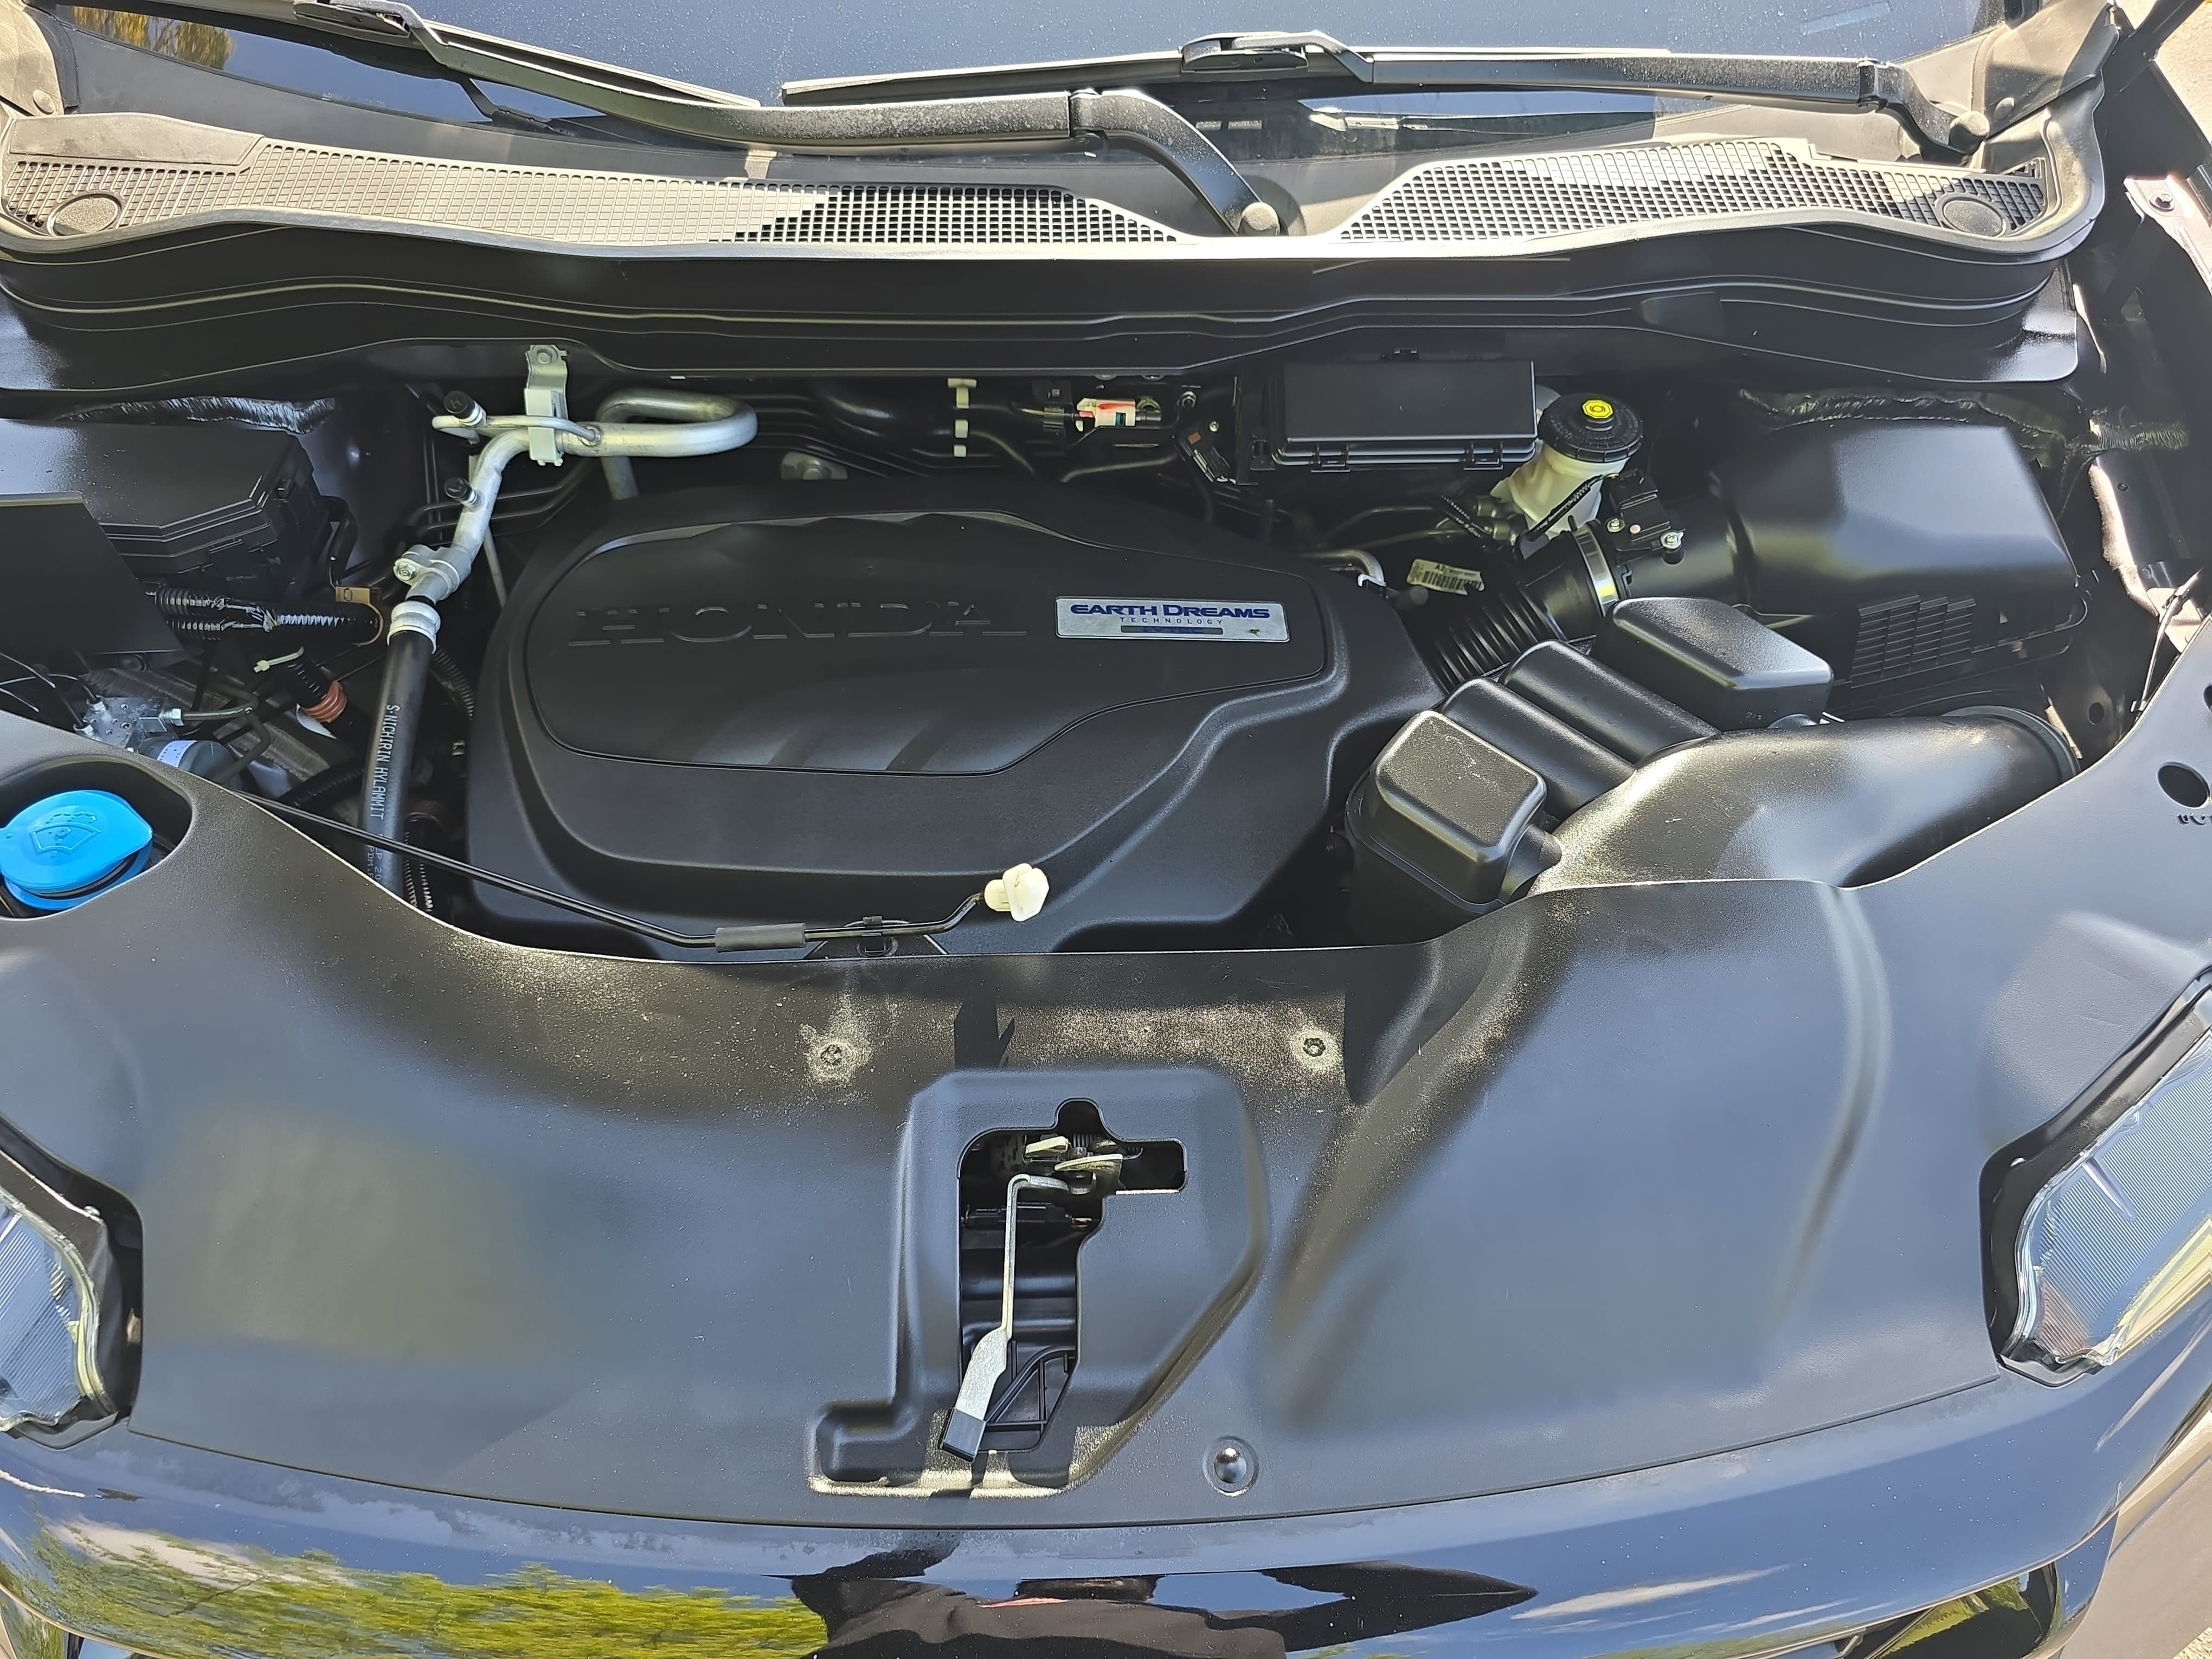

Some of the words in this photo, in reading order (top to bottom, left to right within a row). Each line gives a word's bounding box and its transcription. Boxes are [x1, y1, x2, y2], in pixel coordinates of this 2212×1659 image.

[568, 600, 1027, 646] HONDA
[1070, 604, 1158, 616] EARTH
[1162, 604, 1270, 619] DREAMS
[1120, 616, 1224, 626] TECHNOLOGY
[370, 767, 389, 820] HYLAMMIT
